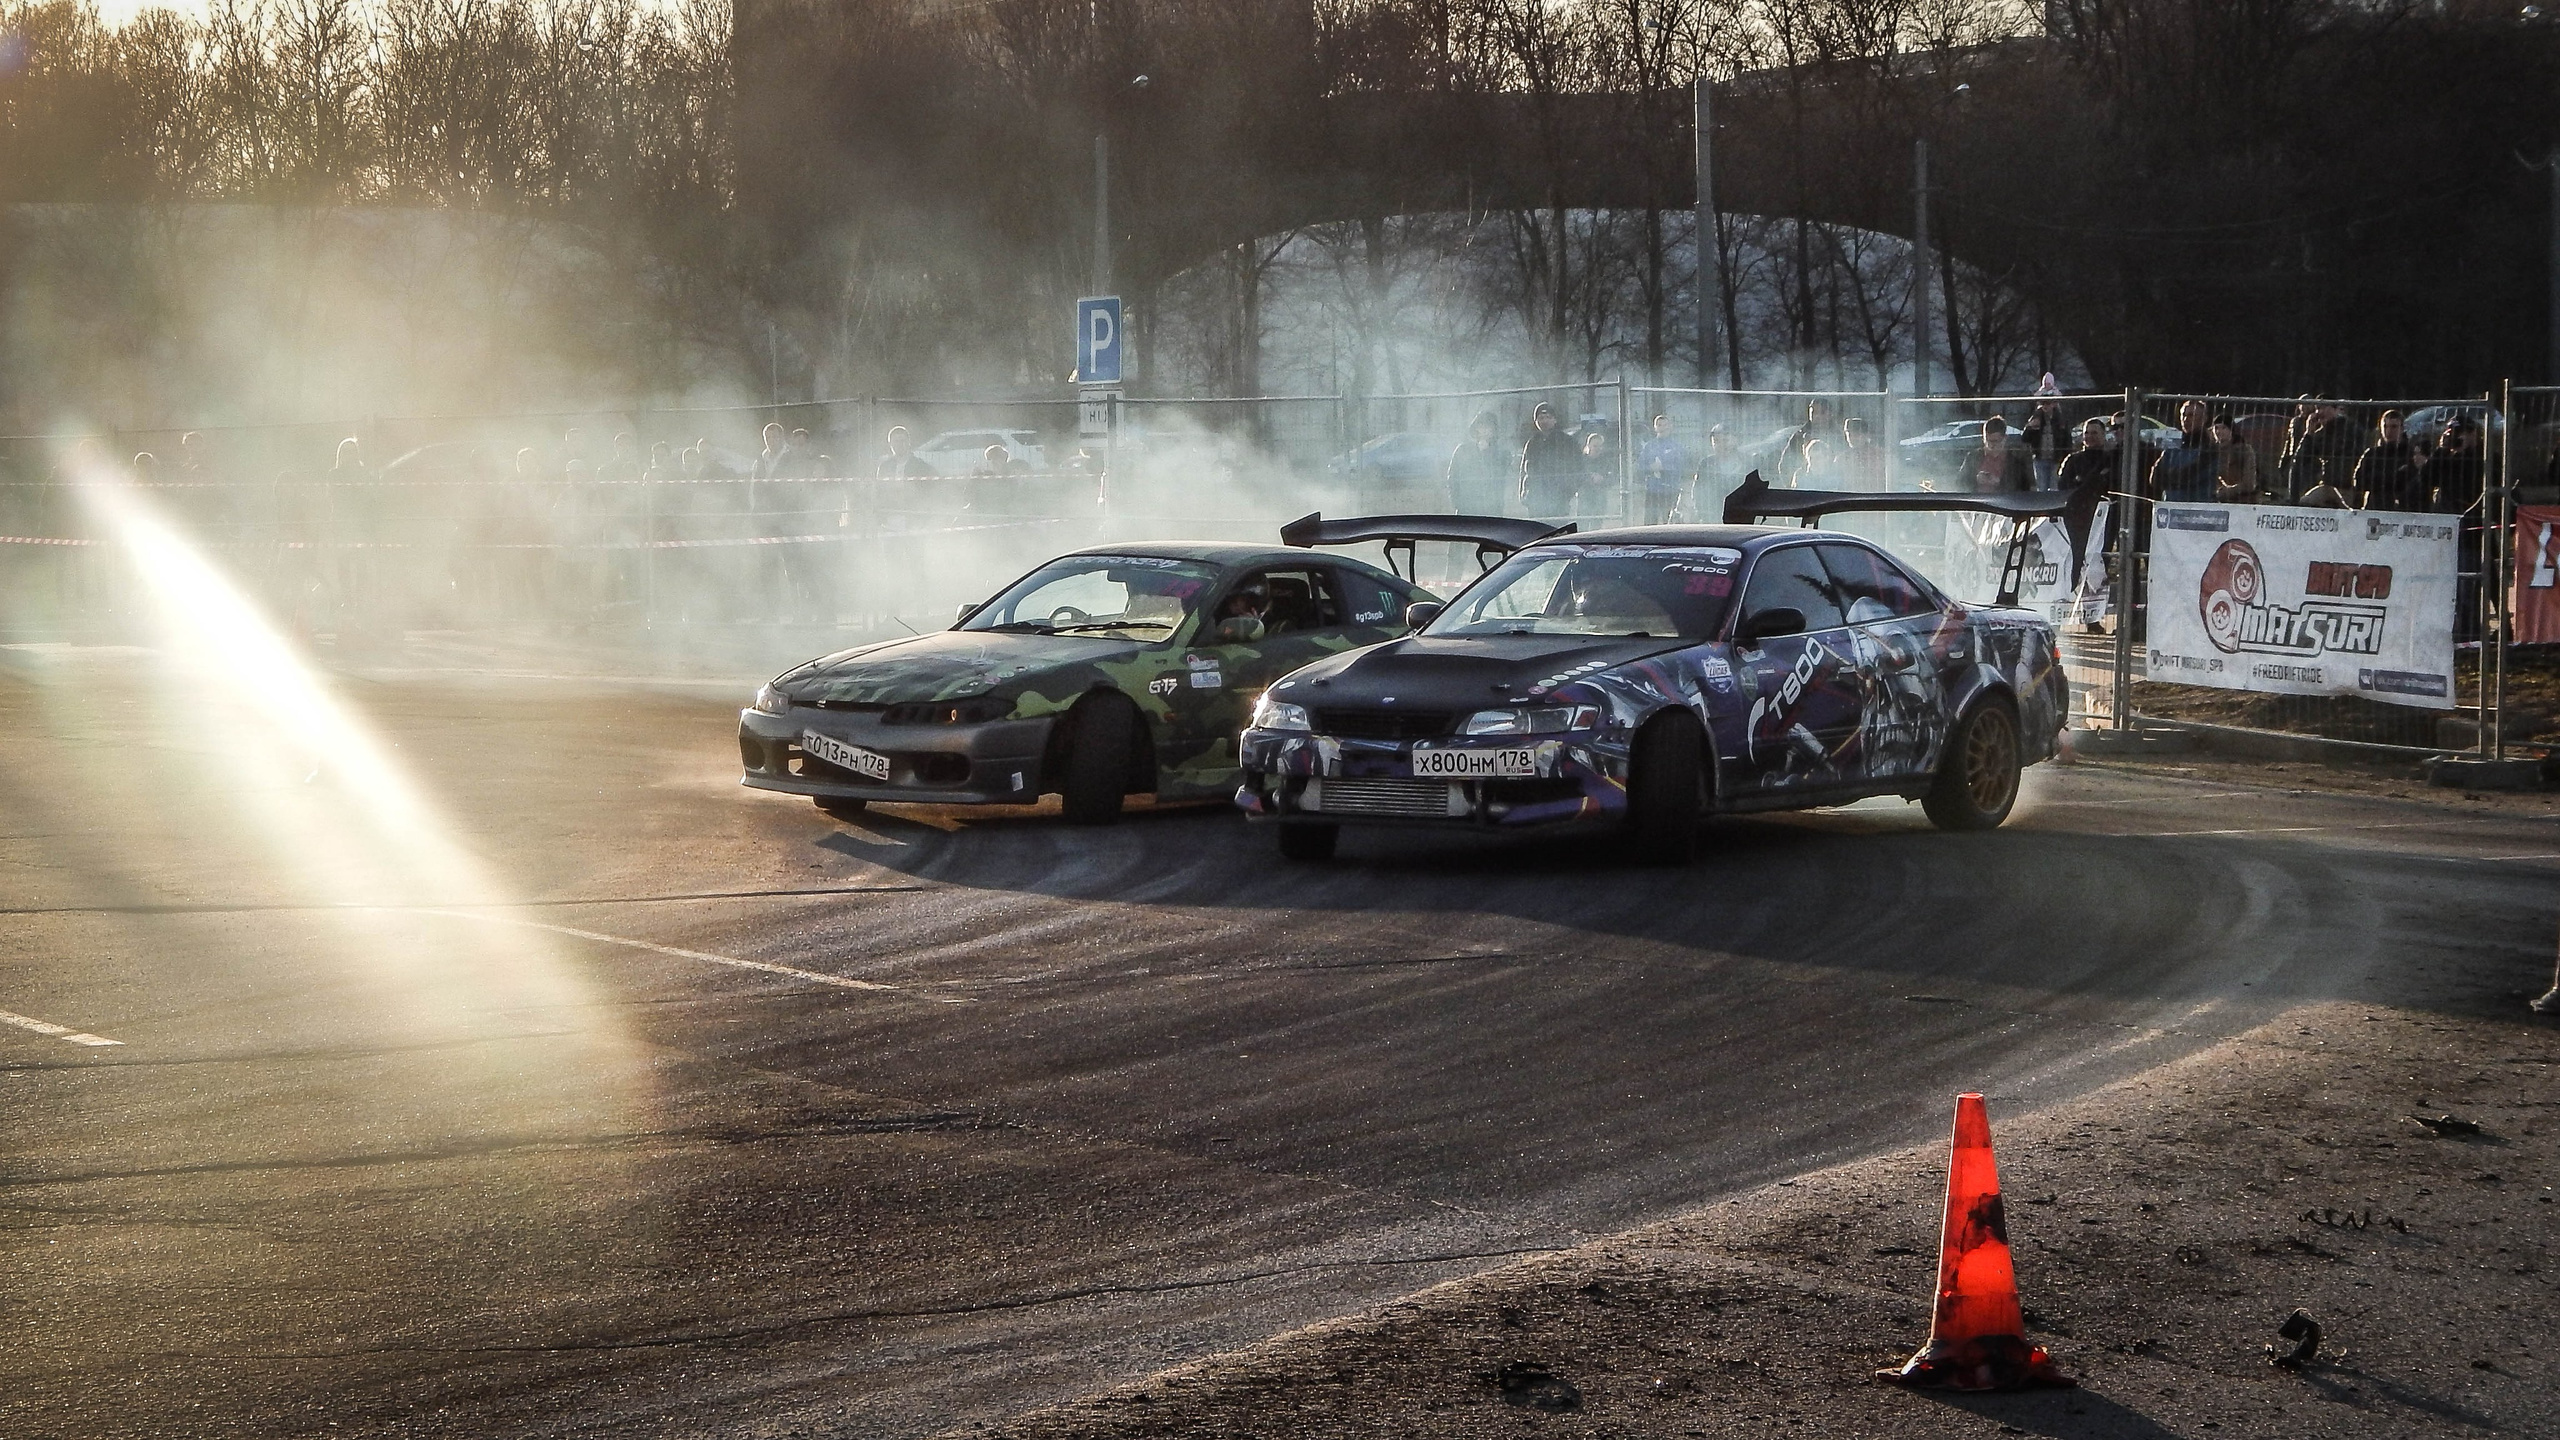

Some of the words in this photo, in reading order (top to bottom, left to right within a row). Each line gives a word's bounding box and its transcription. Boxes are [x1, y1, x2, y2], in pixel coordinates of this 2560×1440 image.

[1090, 308, 1114, 374] P
[2240, 604, 2384, 654] MATSURI
[1768, 636, 1825, 720] T800
[862, 753, 885, 772] 178
[1498, 750, 1530, 767] 178
